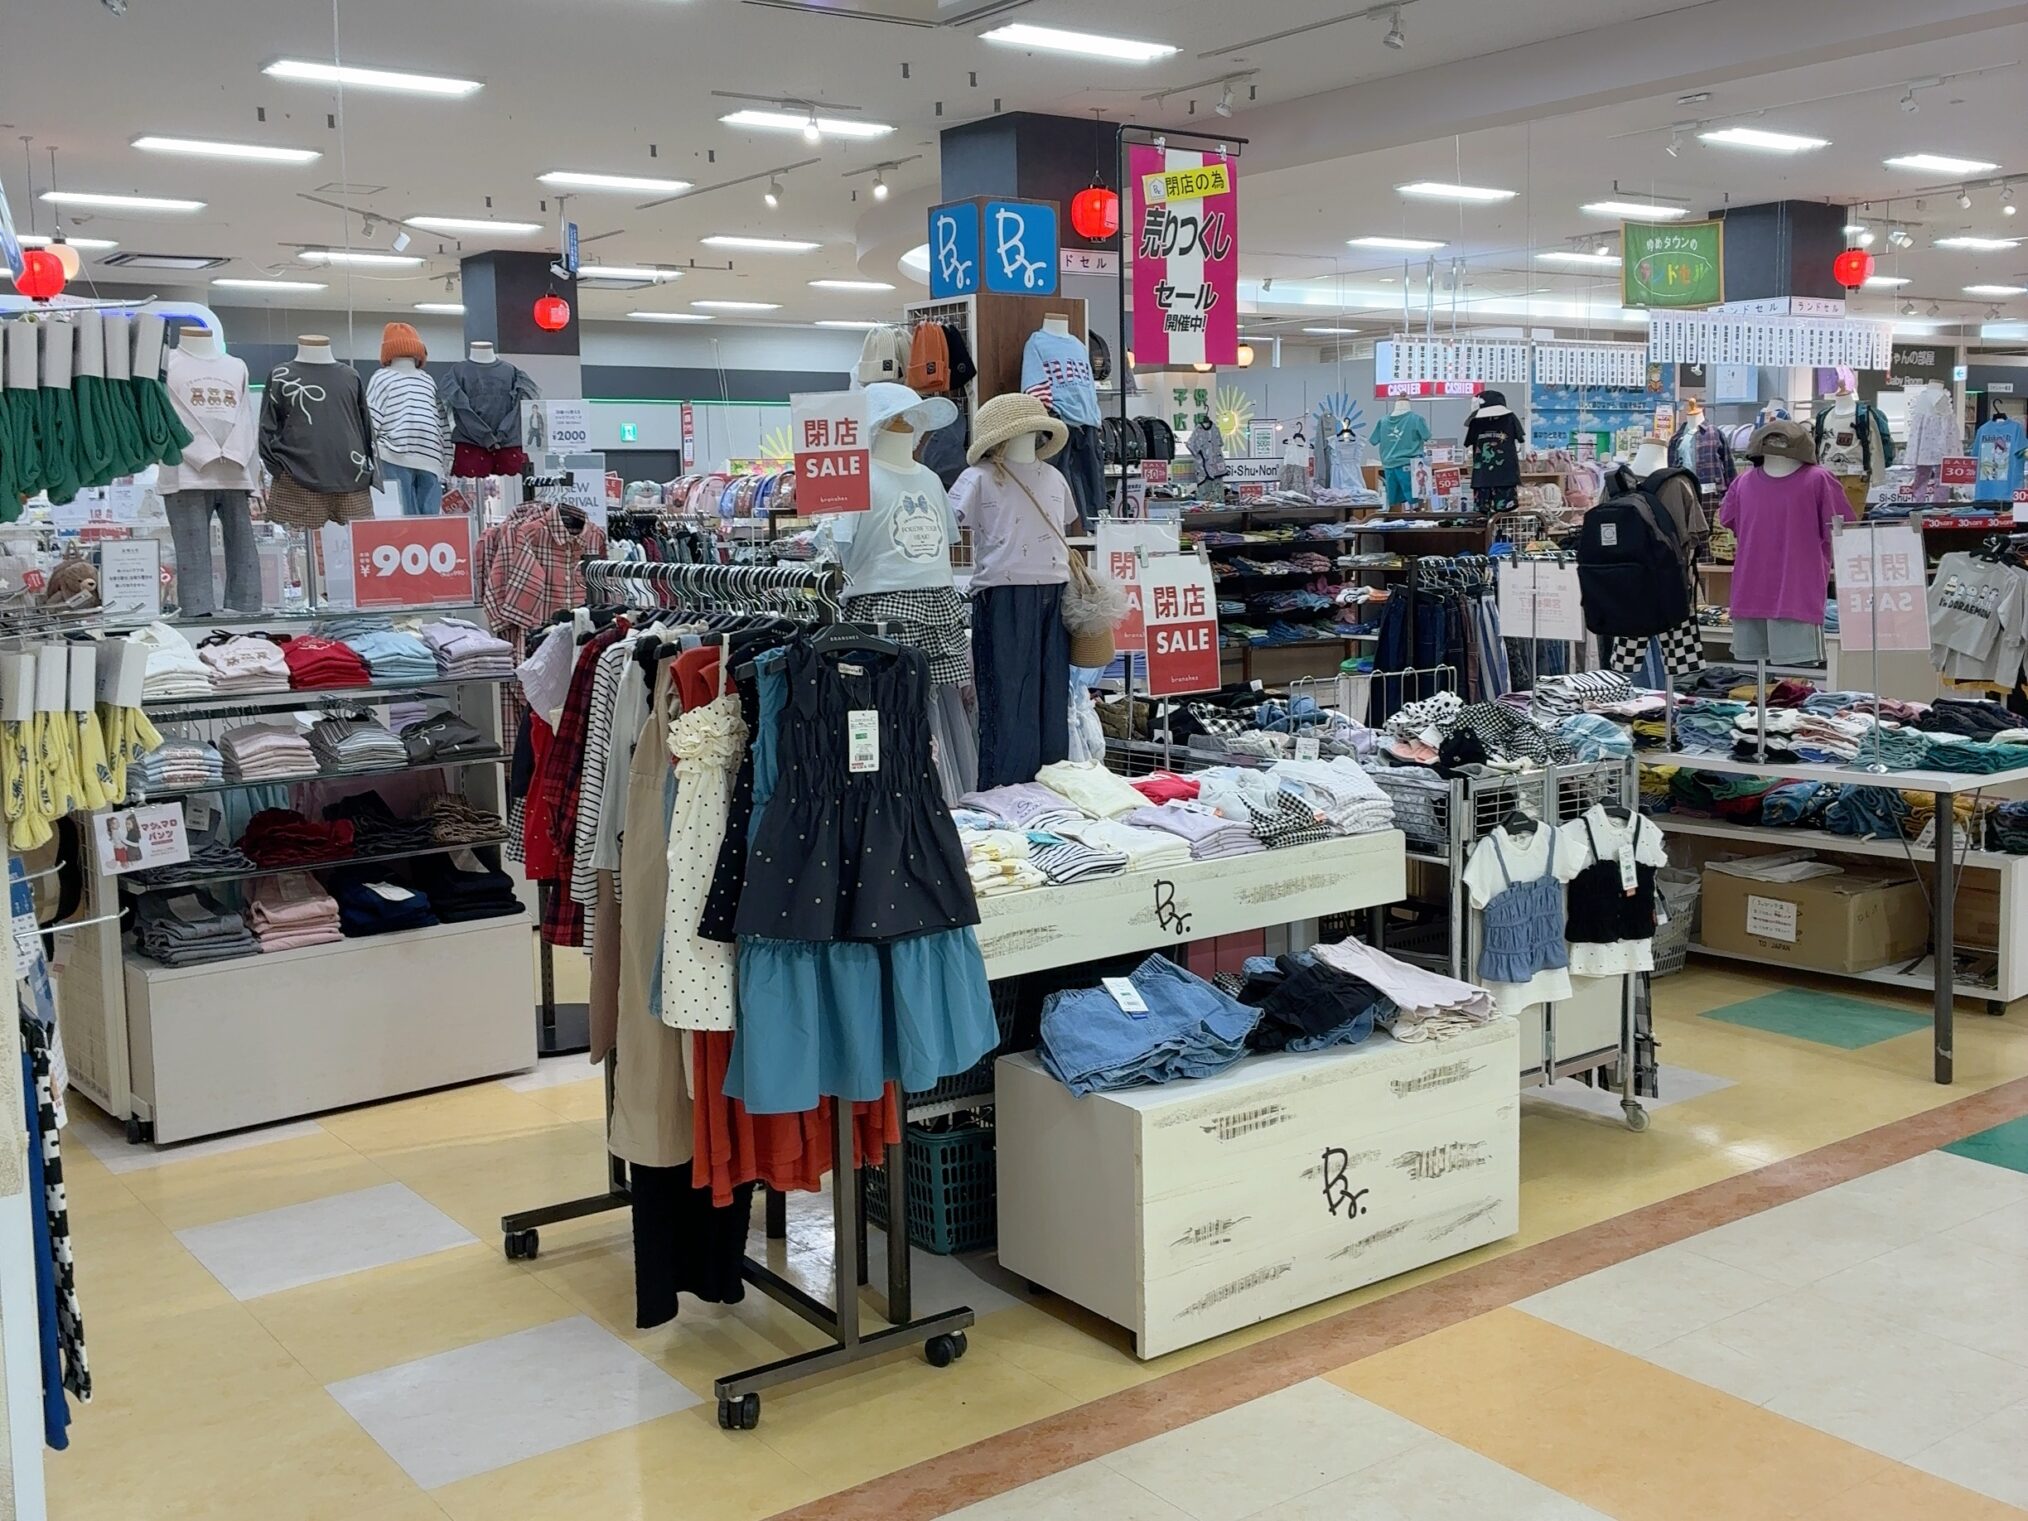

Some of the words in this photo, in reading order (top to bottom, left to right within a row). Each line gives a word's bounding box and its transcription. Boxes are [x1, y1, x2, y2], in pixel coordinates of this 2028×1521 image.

[1165, 170, 1225, 197] 閉店の為
[1140, 207, 1232, 260] 売りつくし
[1646, 236, 1698, 251] ゆめタウンの
[1155, 280, 1217, 310] セール
[1798, 303, 1839, 313] ランドセル
[1164, 314, 1207, 333] 開催中!
[1388, 383, 1421, 396] CASHIER
[1445, 382, 1475, 395] CASHIER
[804, 417, 858, 448] 閉店
[805, 456, 861, 478] SALE
[1110, 551, 1136, 580] 閉
[1153, 584, 1206, 619] 閉店
[1156, 628, 1210, 655] SALE
[140, 818, 178, 832] マシュマロ
